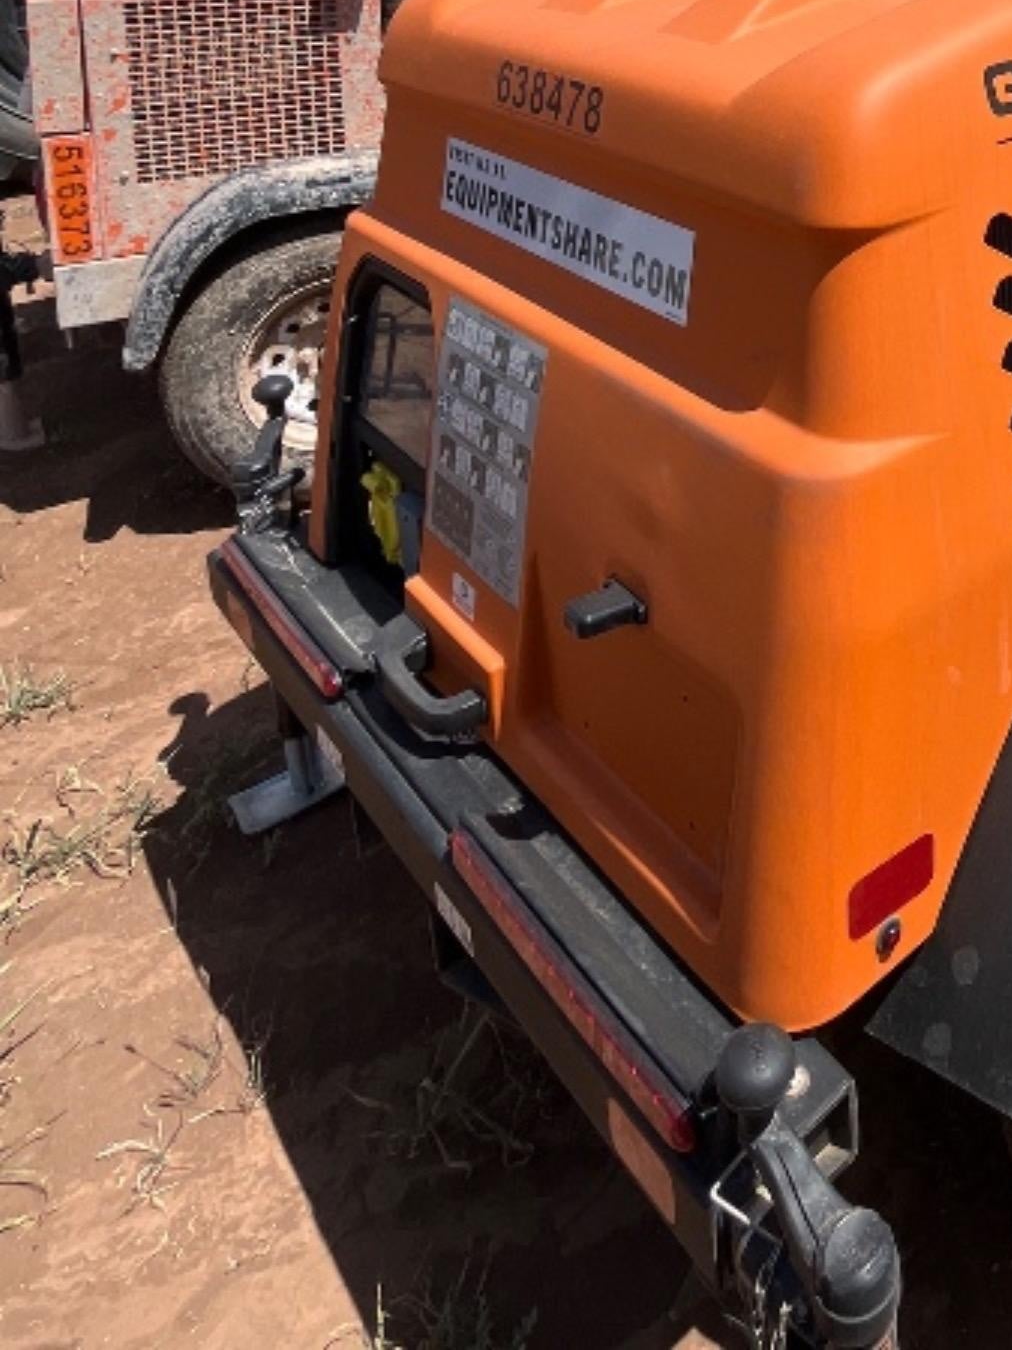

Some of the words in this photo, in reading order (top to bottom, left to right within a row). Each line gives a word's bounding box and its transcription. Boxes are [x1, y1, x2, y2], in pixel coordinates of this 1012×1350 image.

[496, 60, 604, 134] 638478
[52, 146, 93, 257] 516373
[446, 170, 688, 310] EQUIPMENTSHARE.COM
